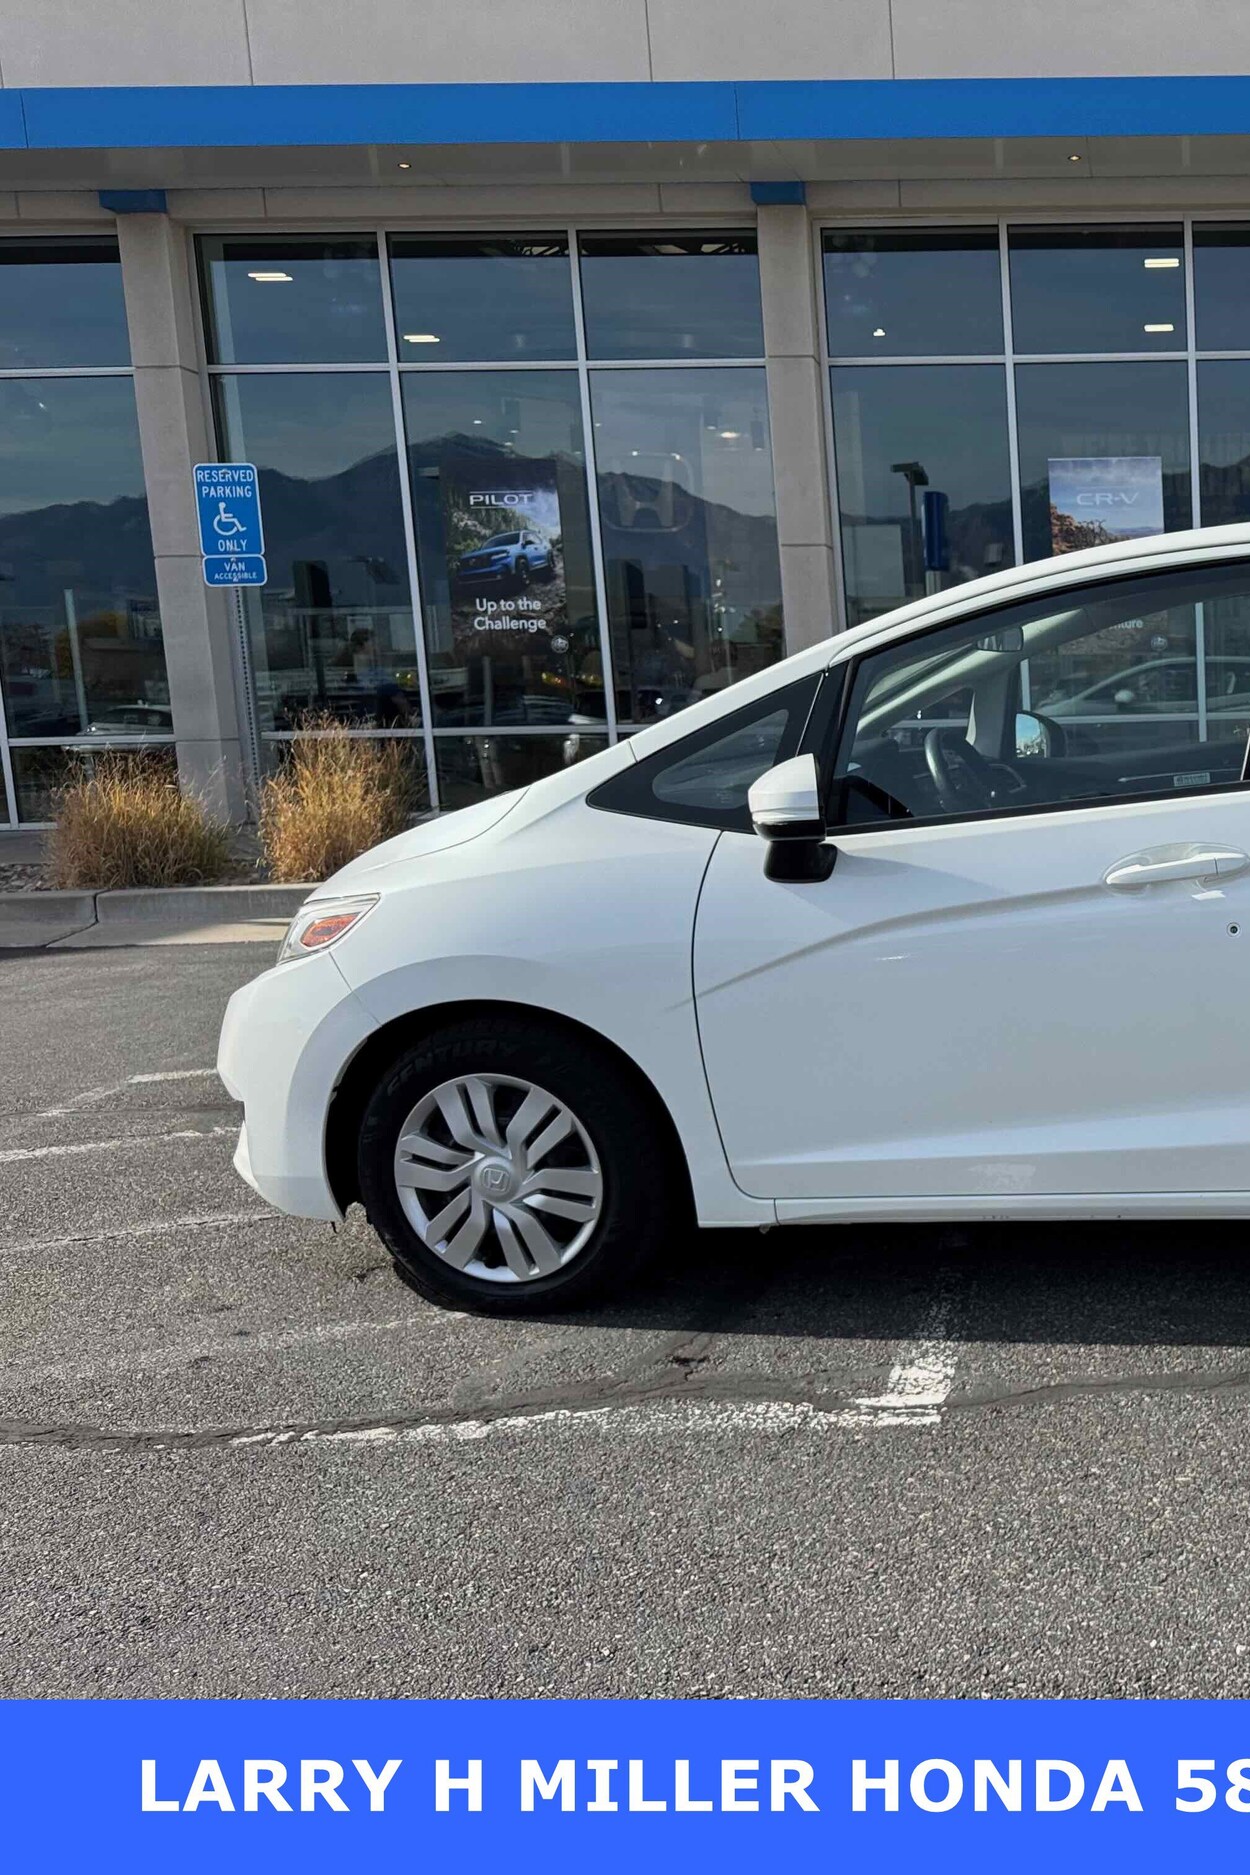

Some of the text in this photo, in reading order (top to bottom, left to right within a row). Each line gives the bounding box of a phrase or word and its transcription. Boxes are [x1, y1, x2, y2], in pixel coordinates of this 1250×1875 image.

[197, 470, 254, 482] RESERVED
[202, 486, 252, 498] PARKING
[469, 493, 533, 506] PILOT
[1076, 492, 1139, 506] CR-V
[218, 539, 247, 552] ONLY
[224, 562, 246, 572] VAN
[214, 571, 258, 580] ACCESSIBLE
[476, 597, 542, 614] Up to the
[474, 616, 547, 632] Challenge
